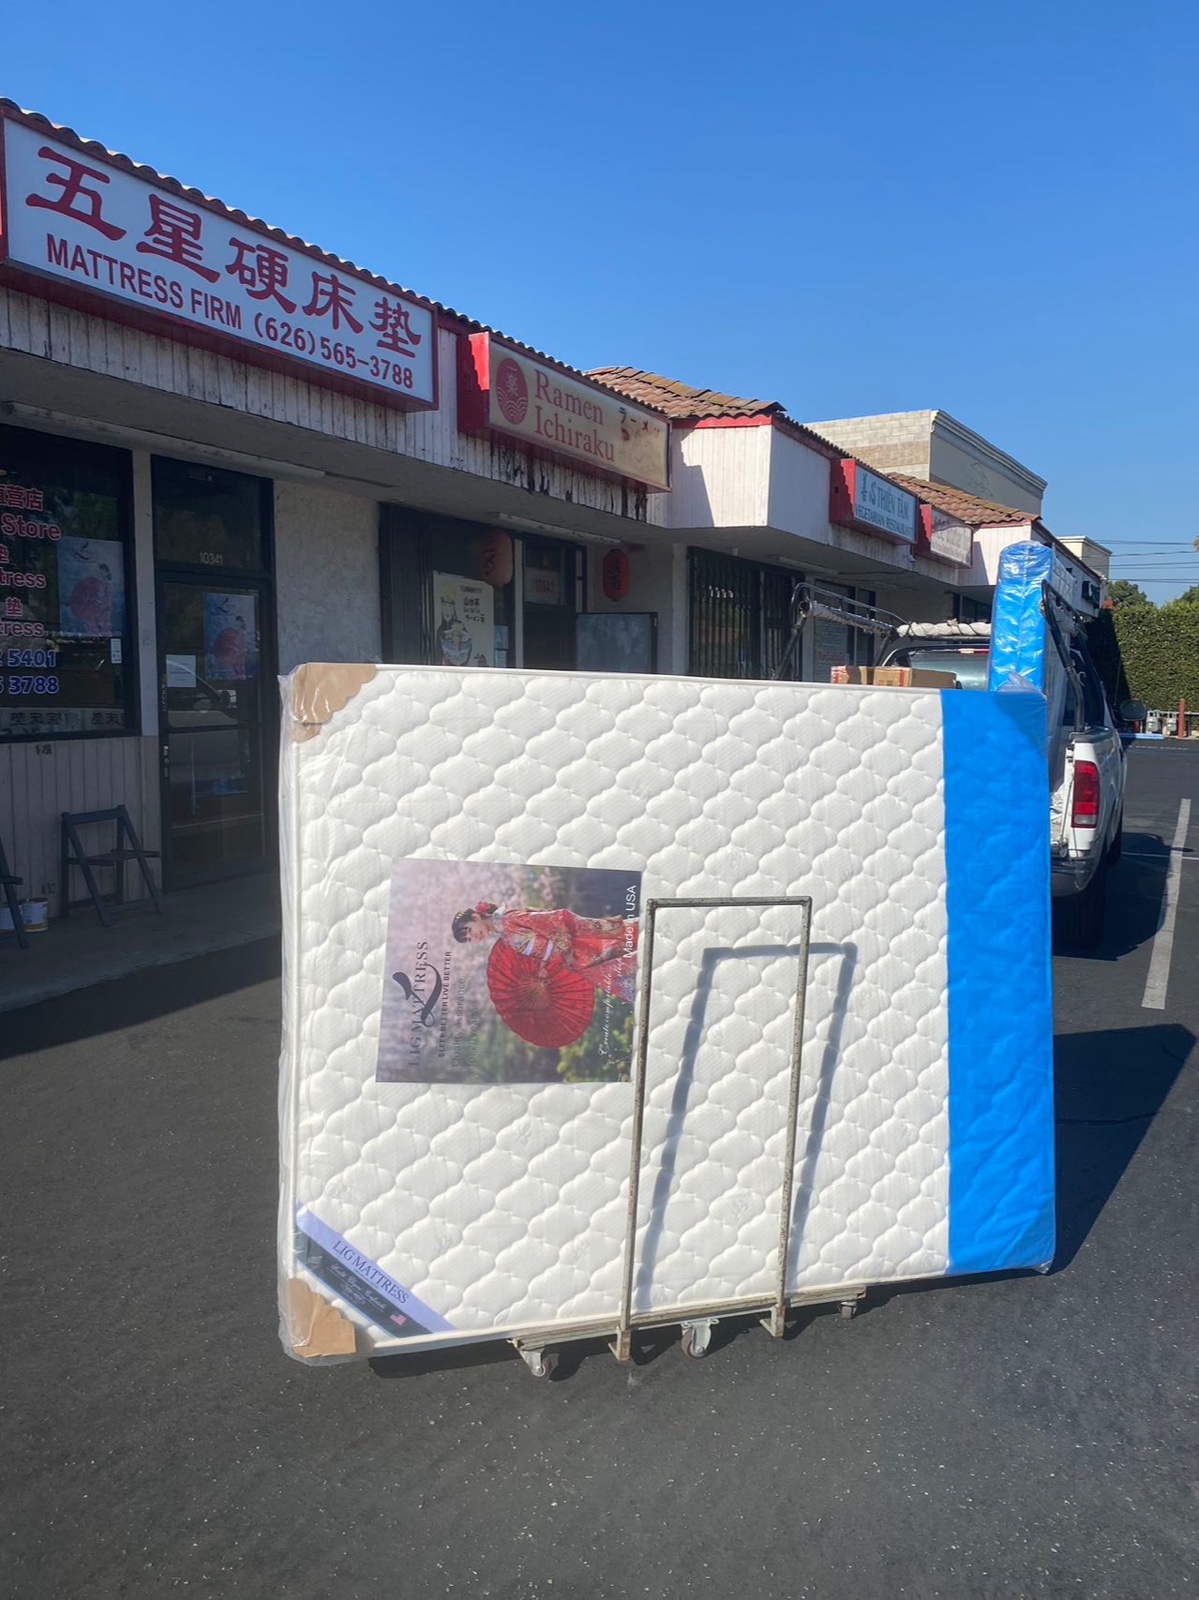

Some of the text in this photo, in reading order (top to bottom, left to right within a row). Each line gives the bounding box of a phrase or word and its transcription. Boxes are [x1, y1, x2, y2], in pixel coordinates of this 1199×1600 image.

[25, 146, 422, 358] 五星硬床垫
[46, 233, 413, 390] MATTRESS FIRM (626)565-3788
[535, 369, 604, 426] Ramen
[535, 405, 615, 462] Ichiraku
[1, 513, 61, 541] Store
[199, 551, 223, 567] 10341
[9, 676, 59, 694] 3788
[626, 885, 637, 911] USA
[623, 927, 634, 958] Made
[408, 941, 428, 1066] LIG MATTRESS
[438, 952, 452, 1057] SLEEP BETTER LIVE BETTER
[451, 977, 466, 1067] Quality assurance
[598, 973, 614, 1055] Create comfortable
[333, 1240, 355, 1260] LIG
[352, 1256, 409, 1304] MATTRESS
